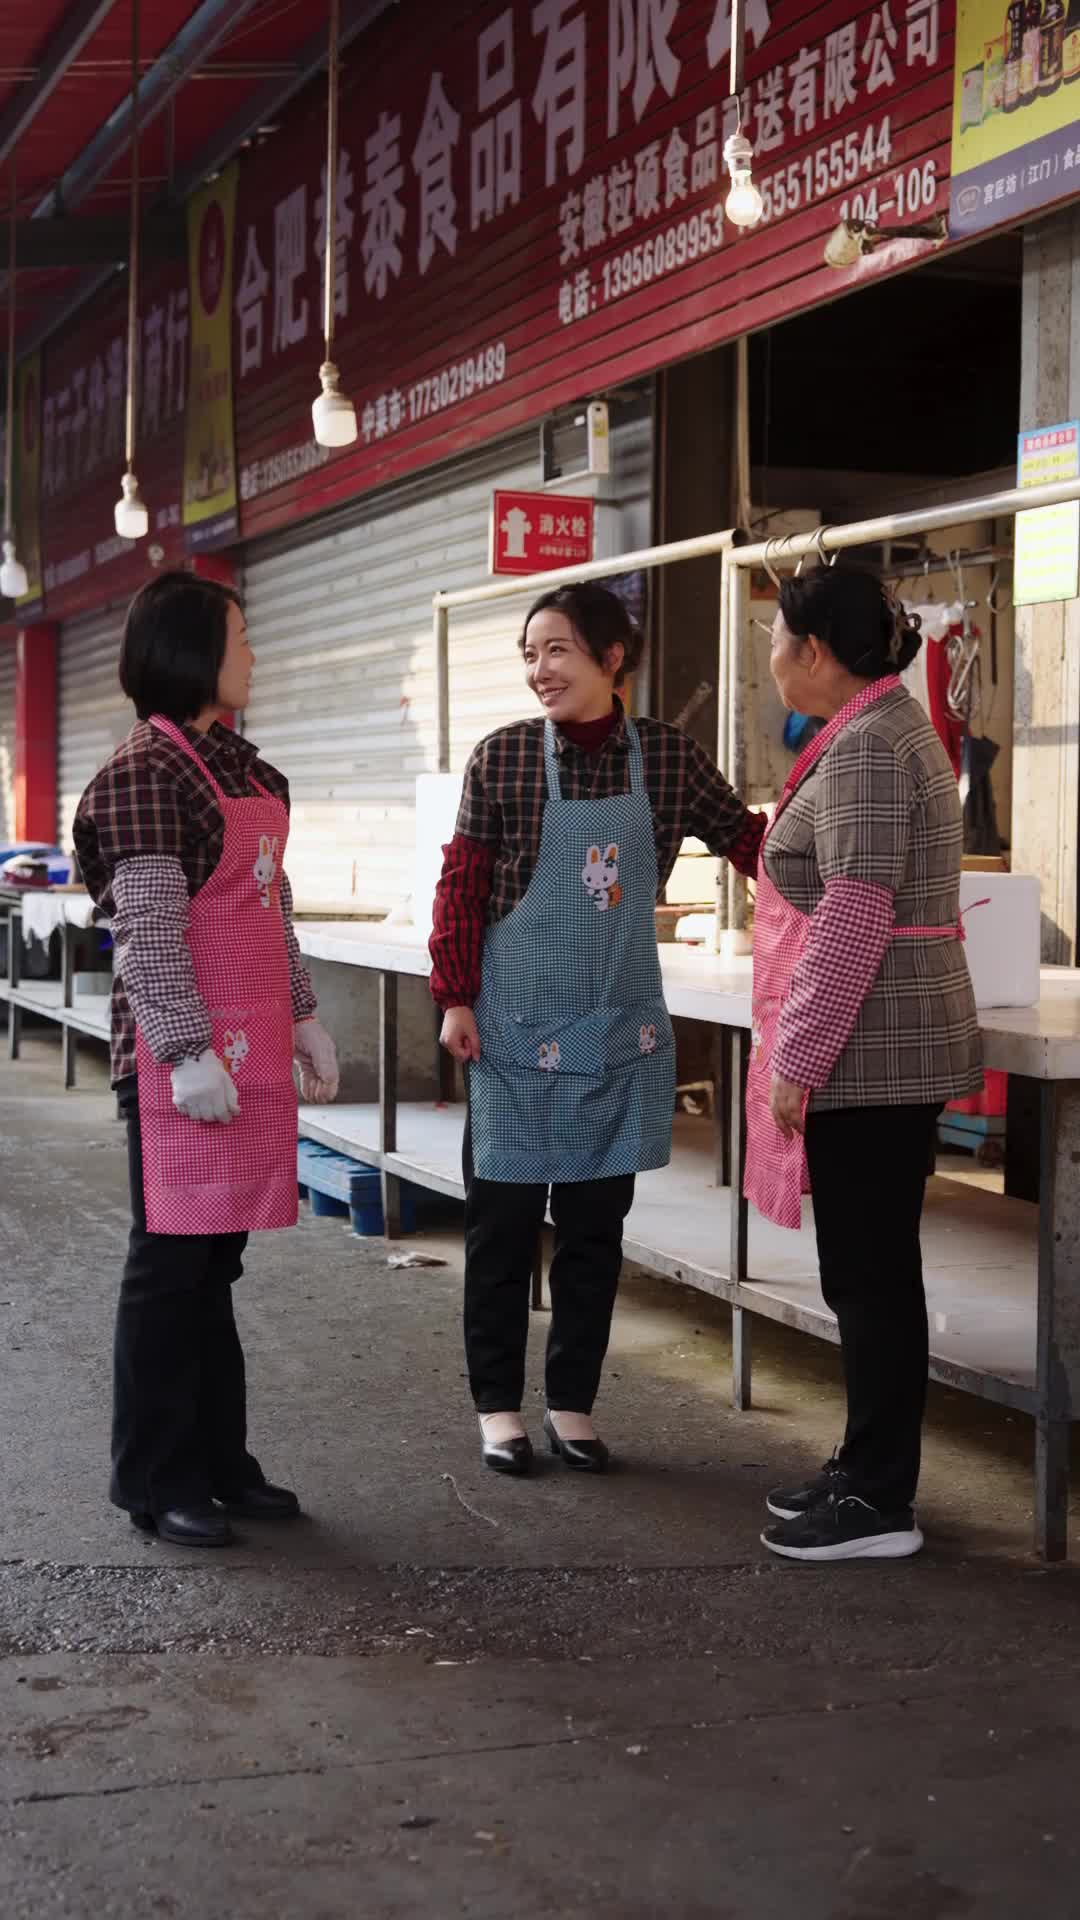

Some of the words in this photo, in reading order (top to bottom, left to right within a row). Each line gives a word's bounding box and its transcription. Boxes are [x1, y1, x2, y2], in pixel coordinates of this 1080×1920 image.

[736, 115, 892, 235] 555155544
[839, 159, 937, 226] 104-106
[538, 513, 588, 537] 消火栓
